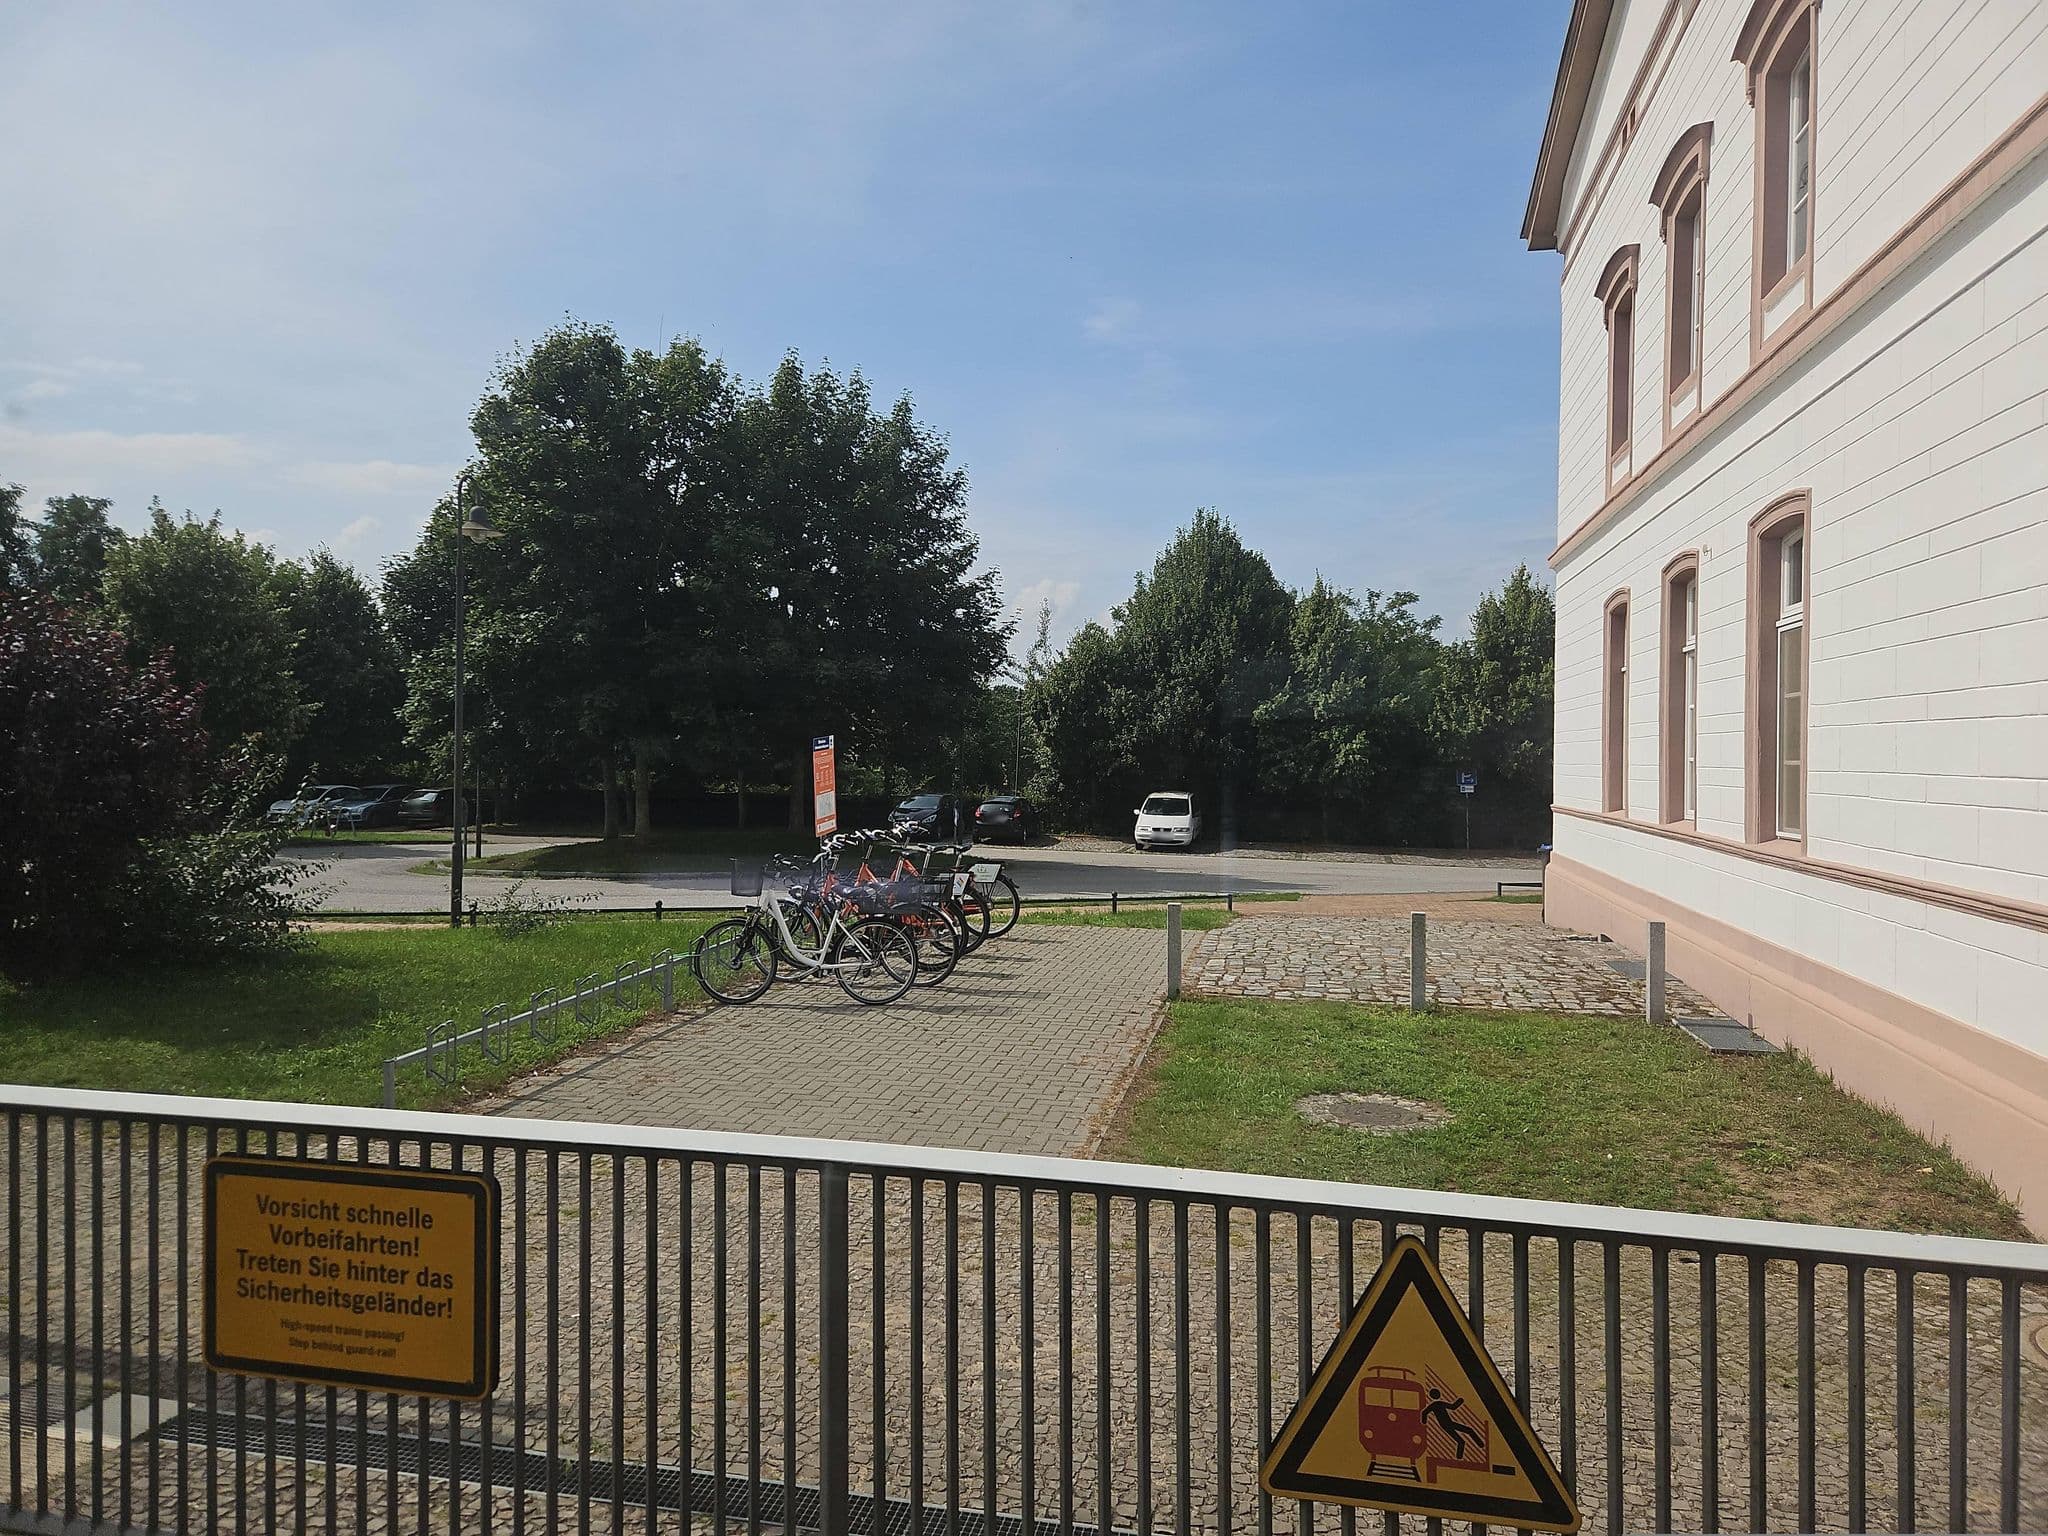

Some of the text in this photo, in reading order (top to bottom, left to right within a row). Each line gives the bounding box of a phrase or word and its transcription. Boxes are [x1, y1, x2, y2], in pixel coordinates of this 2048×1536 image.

[256, 1193, 433, 1229] Vorsicht schnelle
[269, 1223, 420, 1257] Vorbeifahrten!
[236, 1248, 454, 1290] Treten Sie hinter das
[236, 1277, 453, 1318] Sicherheitsgeländer!
[280, 1319, 333, 1335] High-speed
